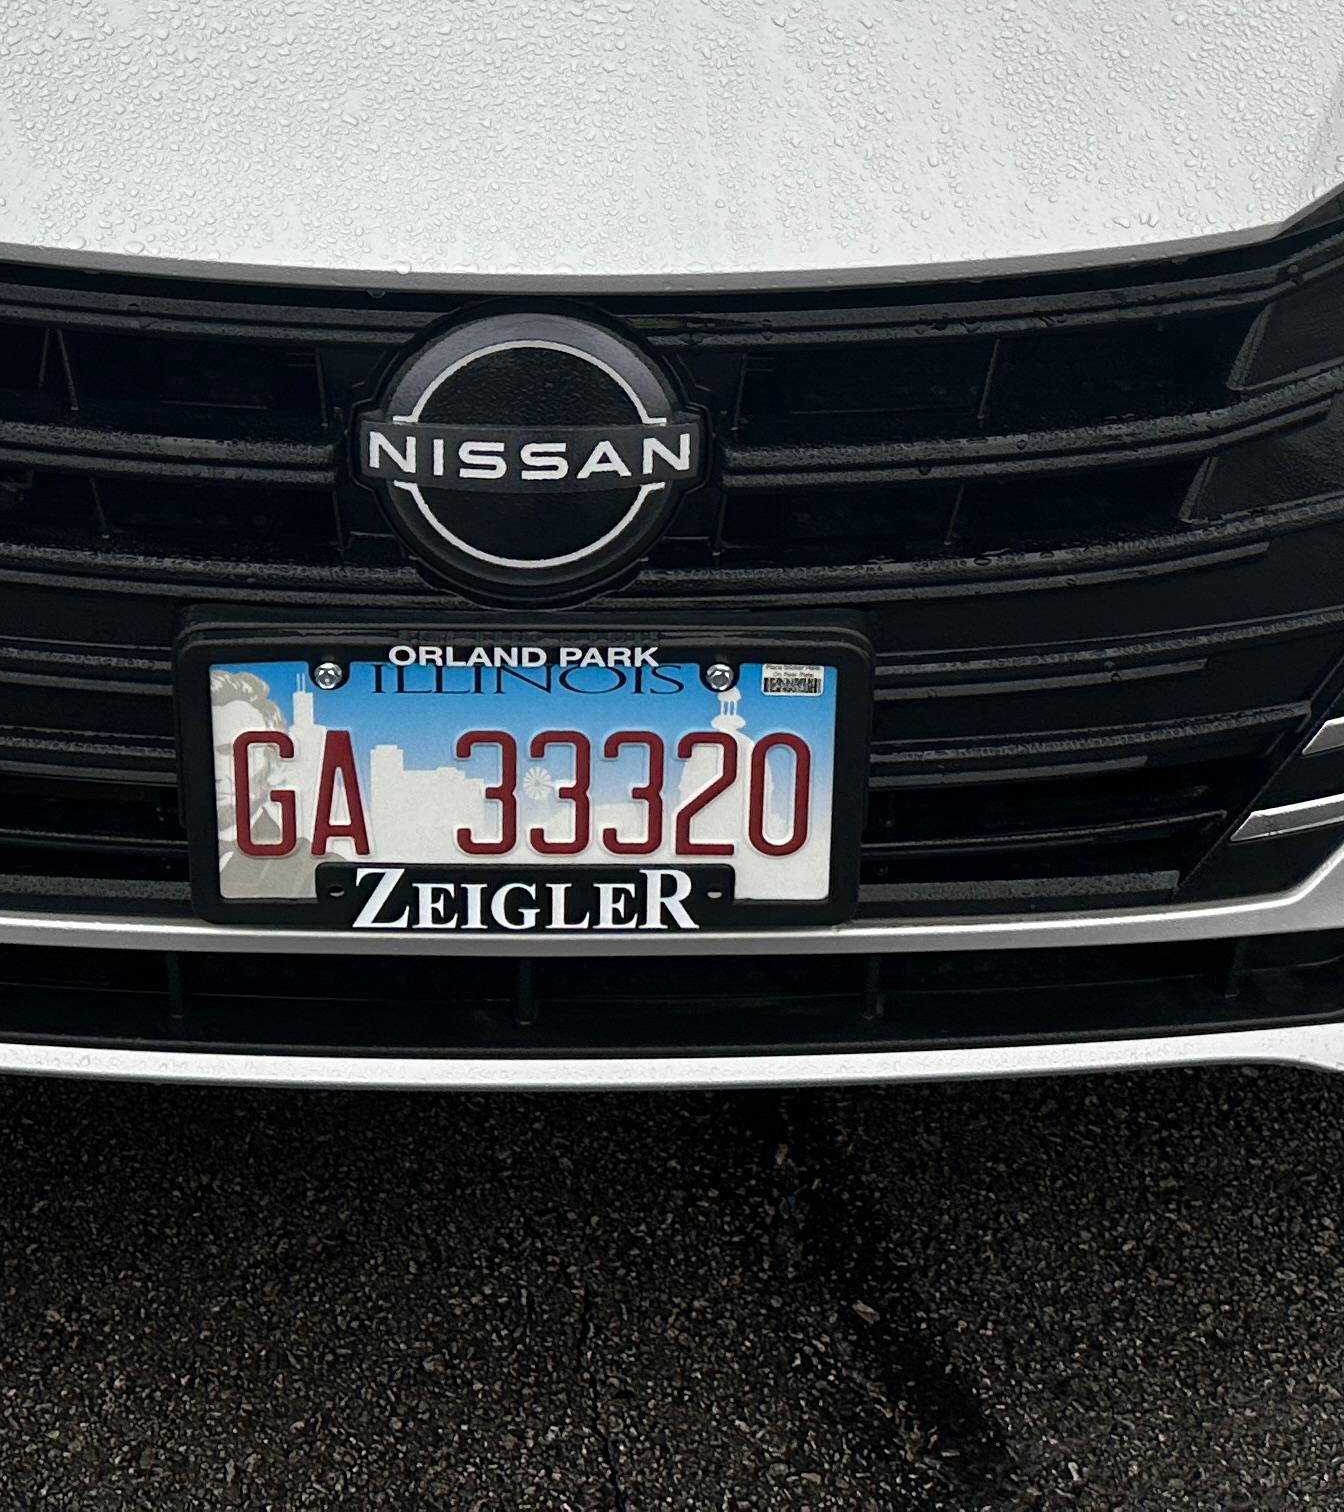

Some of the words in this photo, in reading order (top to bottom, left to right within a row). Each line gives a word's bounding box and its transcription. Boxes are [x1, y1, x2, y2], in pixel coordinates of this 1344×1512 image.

[369, 431, 691, 481] NISSAN
[371, 664, 685, 695] ILLINOIS
[388, 645, 547, 668] ORLAND
[559, 646, 660, 668] PARK
[233, 730, 370, 857] GA
[456, 730, 811, 857] 33320
[352, 868, 700, 930] ZEIGLER
